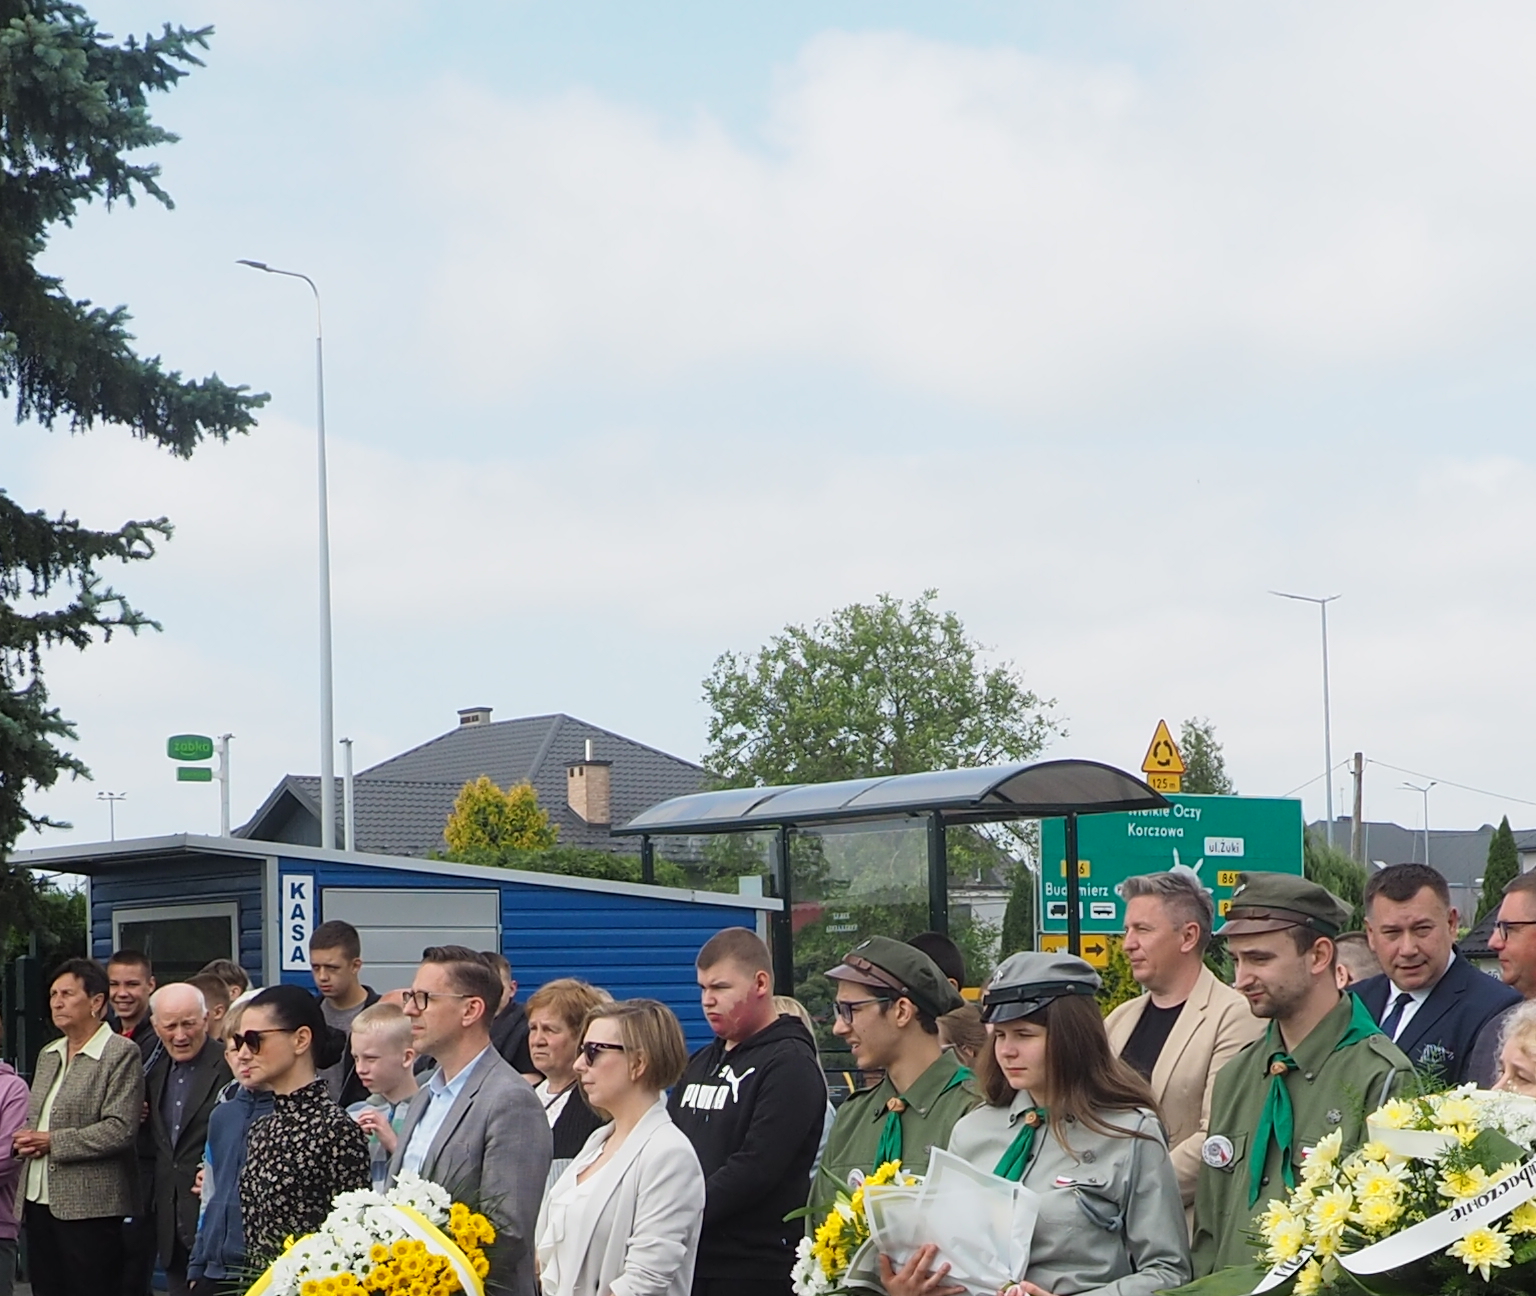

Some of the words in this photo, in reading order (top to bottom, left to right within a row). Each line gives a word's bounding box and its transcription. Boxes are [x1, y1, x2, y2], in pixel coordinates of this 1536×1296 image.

[1173, 803, 1202, 822] Oczy
[1127, 822, 1184, 838] Korczowa
[1045, 881, 1109, 897] Bumierz
[290, 881, 306, 963] KASA
[679, 1083, 731, 1111] PUMA
